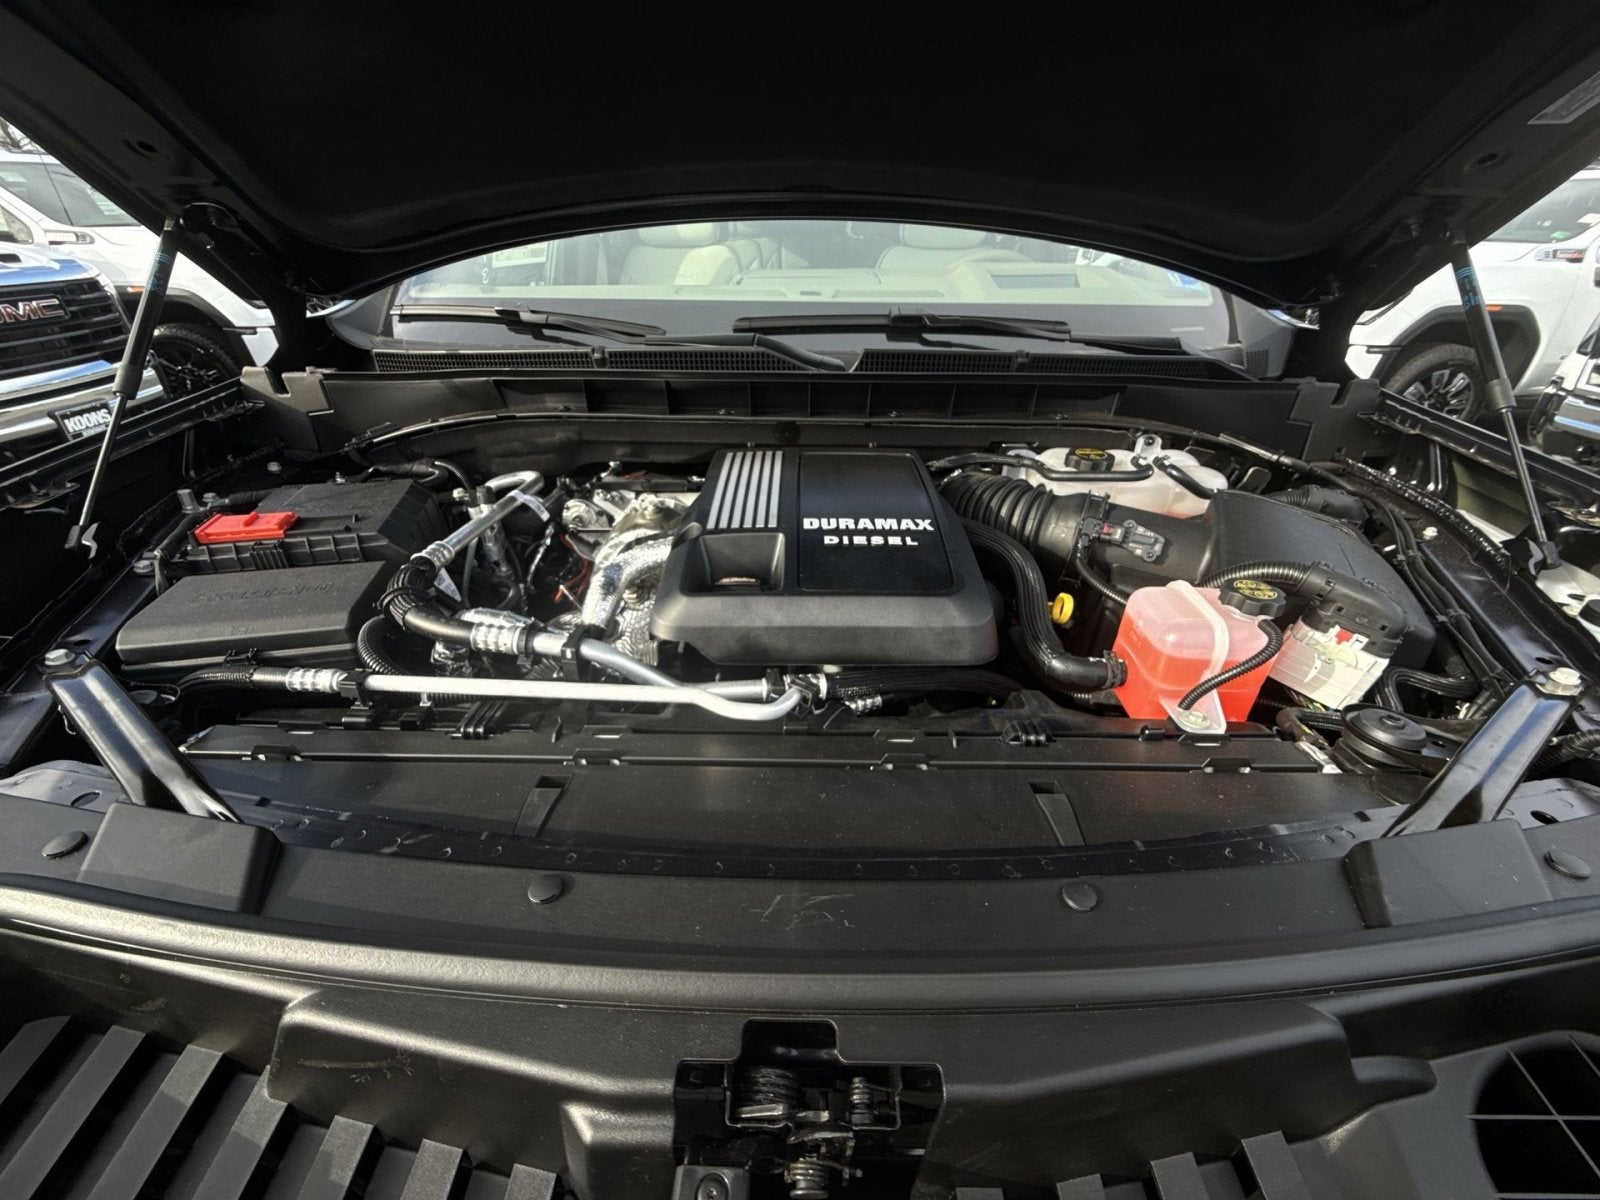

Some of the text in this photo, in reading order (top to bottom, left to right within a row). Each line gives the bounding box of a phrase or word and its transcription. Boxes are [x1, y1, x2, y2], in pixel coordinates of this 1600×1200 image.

[0, 298, 65, 323] MC
[63, 408, 111, 433] KOONS
[802, 517, 935, 531] DURAMAX
[823, 535, 919, 546] DIESEL
